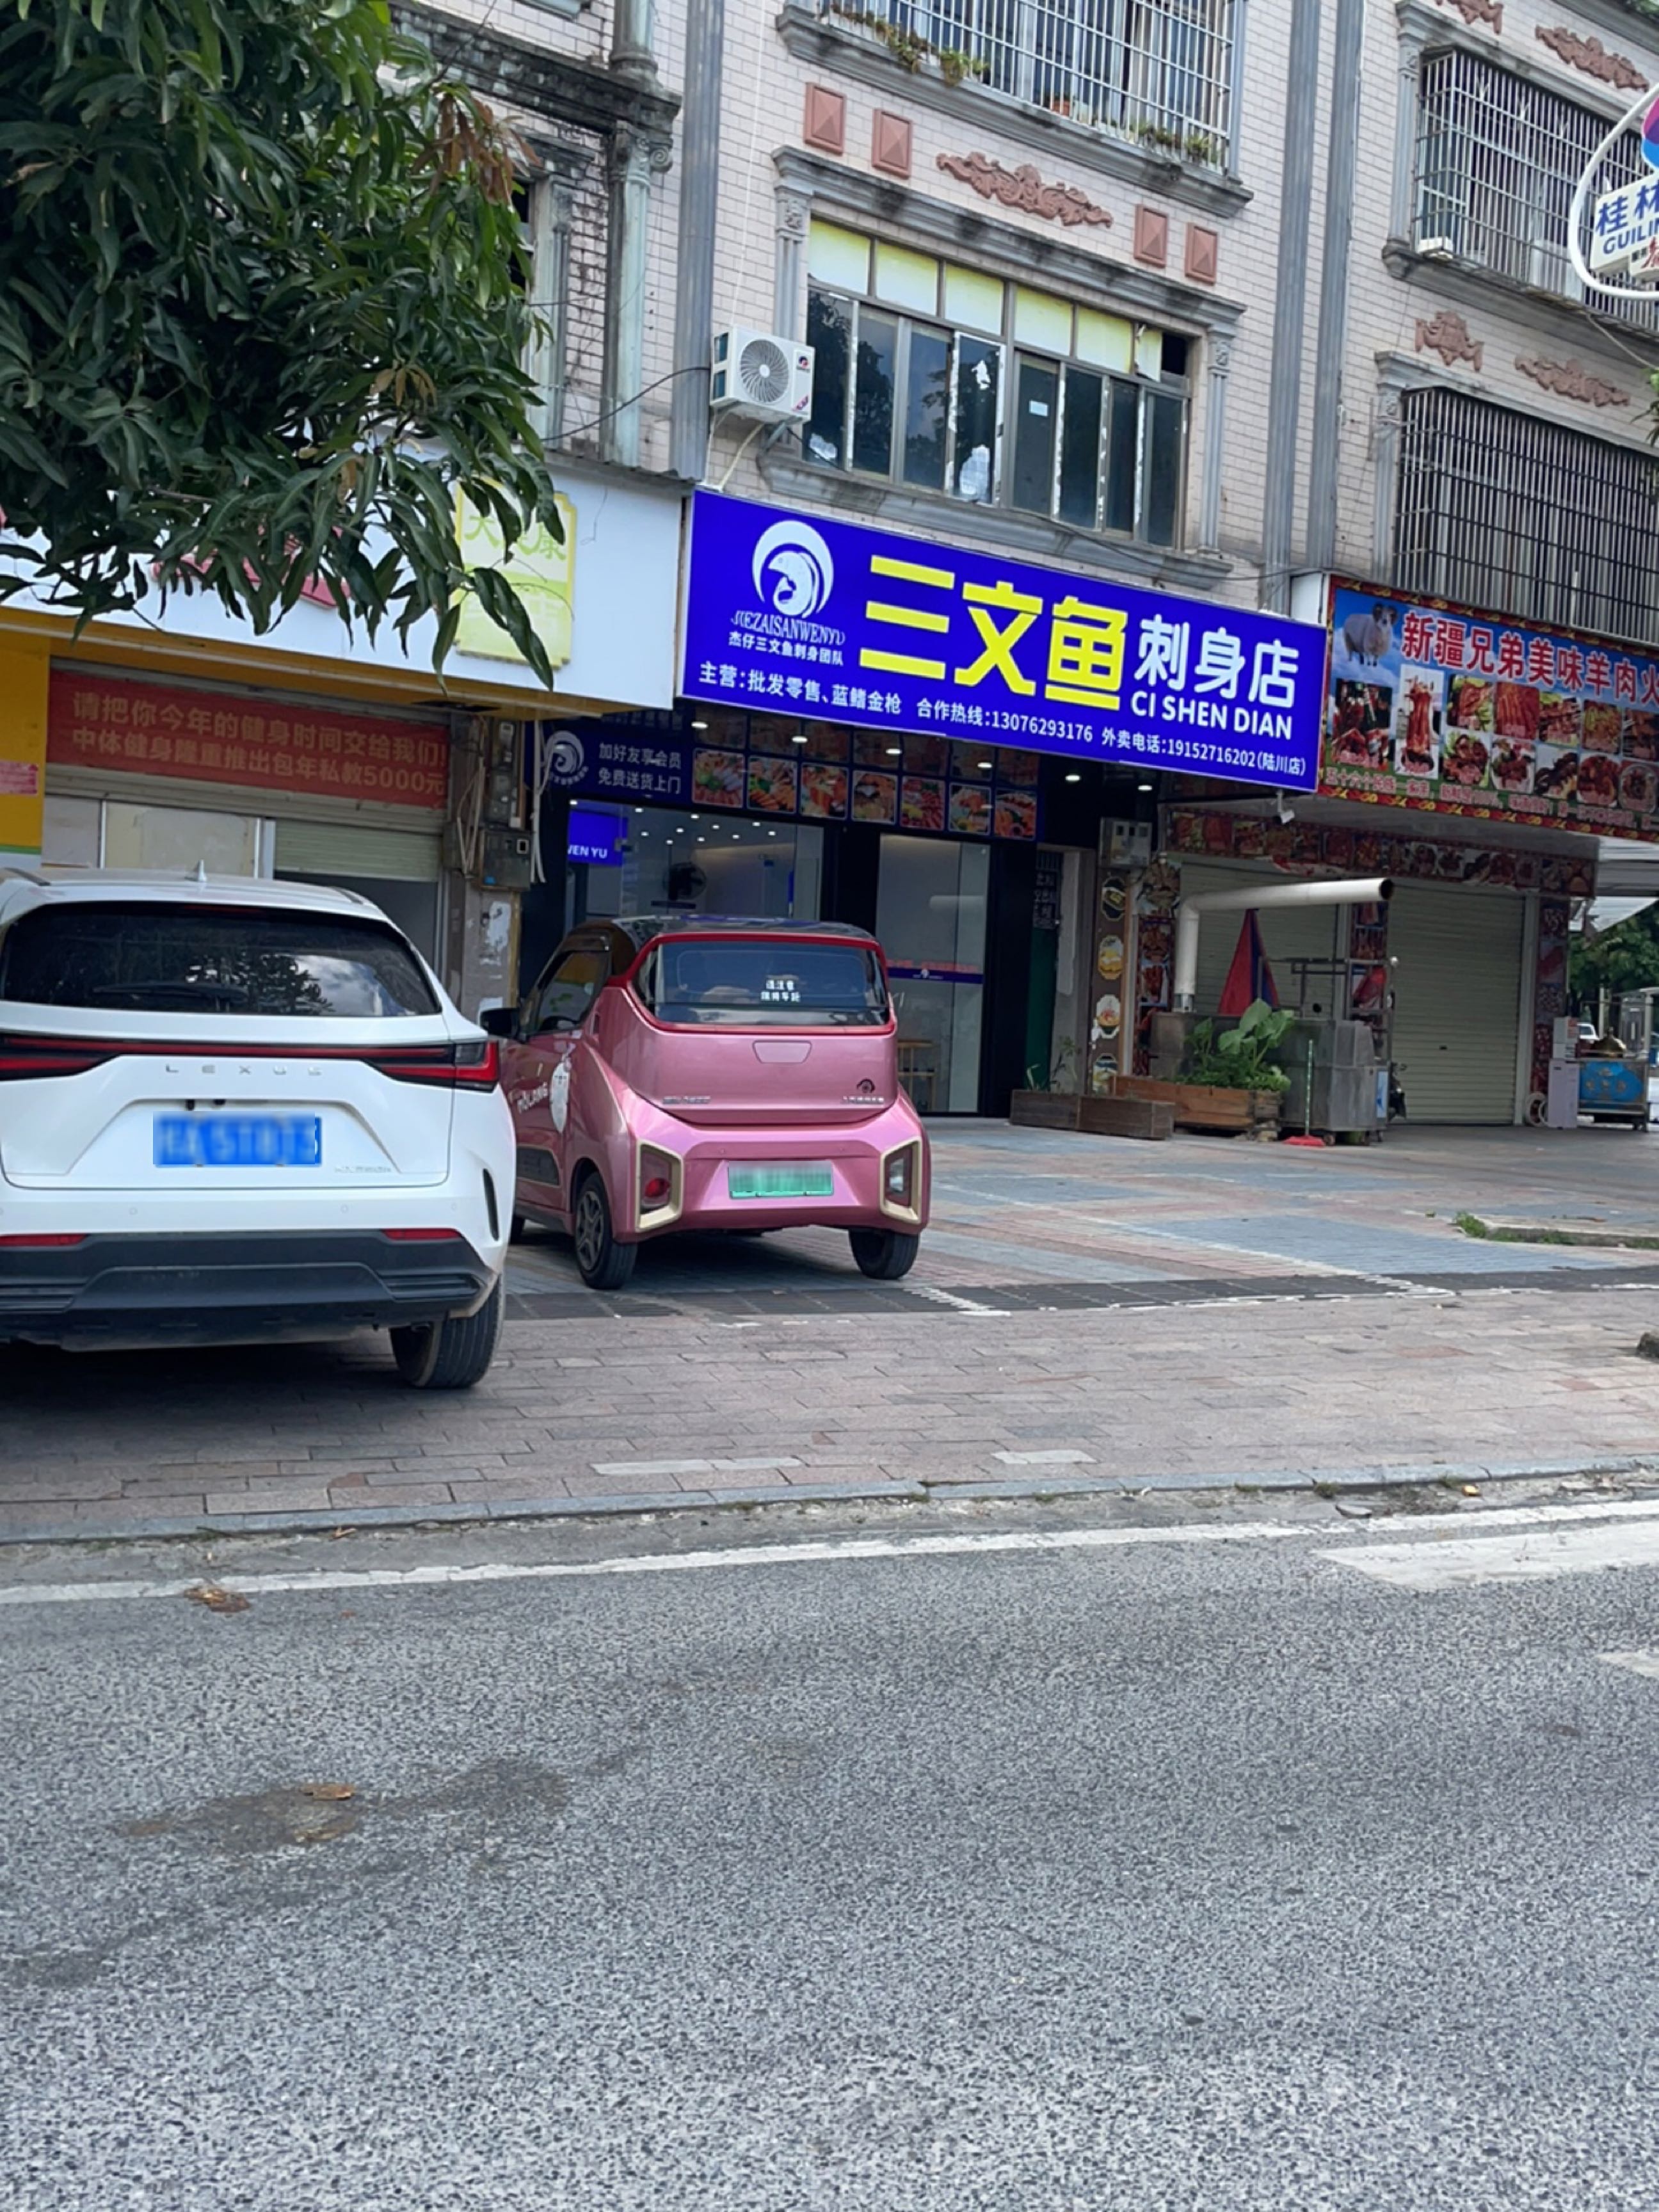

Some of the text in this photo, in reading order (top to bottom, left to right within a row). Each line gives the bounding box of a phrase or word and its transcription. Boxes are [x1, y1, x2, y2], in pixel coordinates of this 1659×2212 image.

[728, 630, 844, 666] 杰仔三文鱼刺身团队
[859, 555, 1300, 711] 三文鱼 刺身店
[1130, 690, 1292, 741] CI SHEN DIAN
[598, 767, 682, 794] 免费送货上门
[591, 847, 608, 859] YU
[165, 1064, 322, 1077] LEXUS
